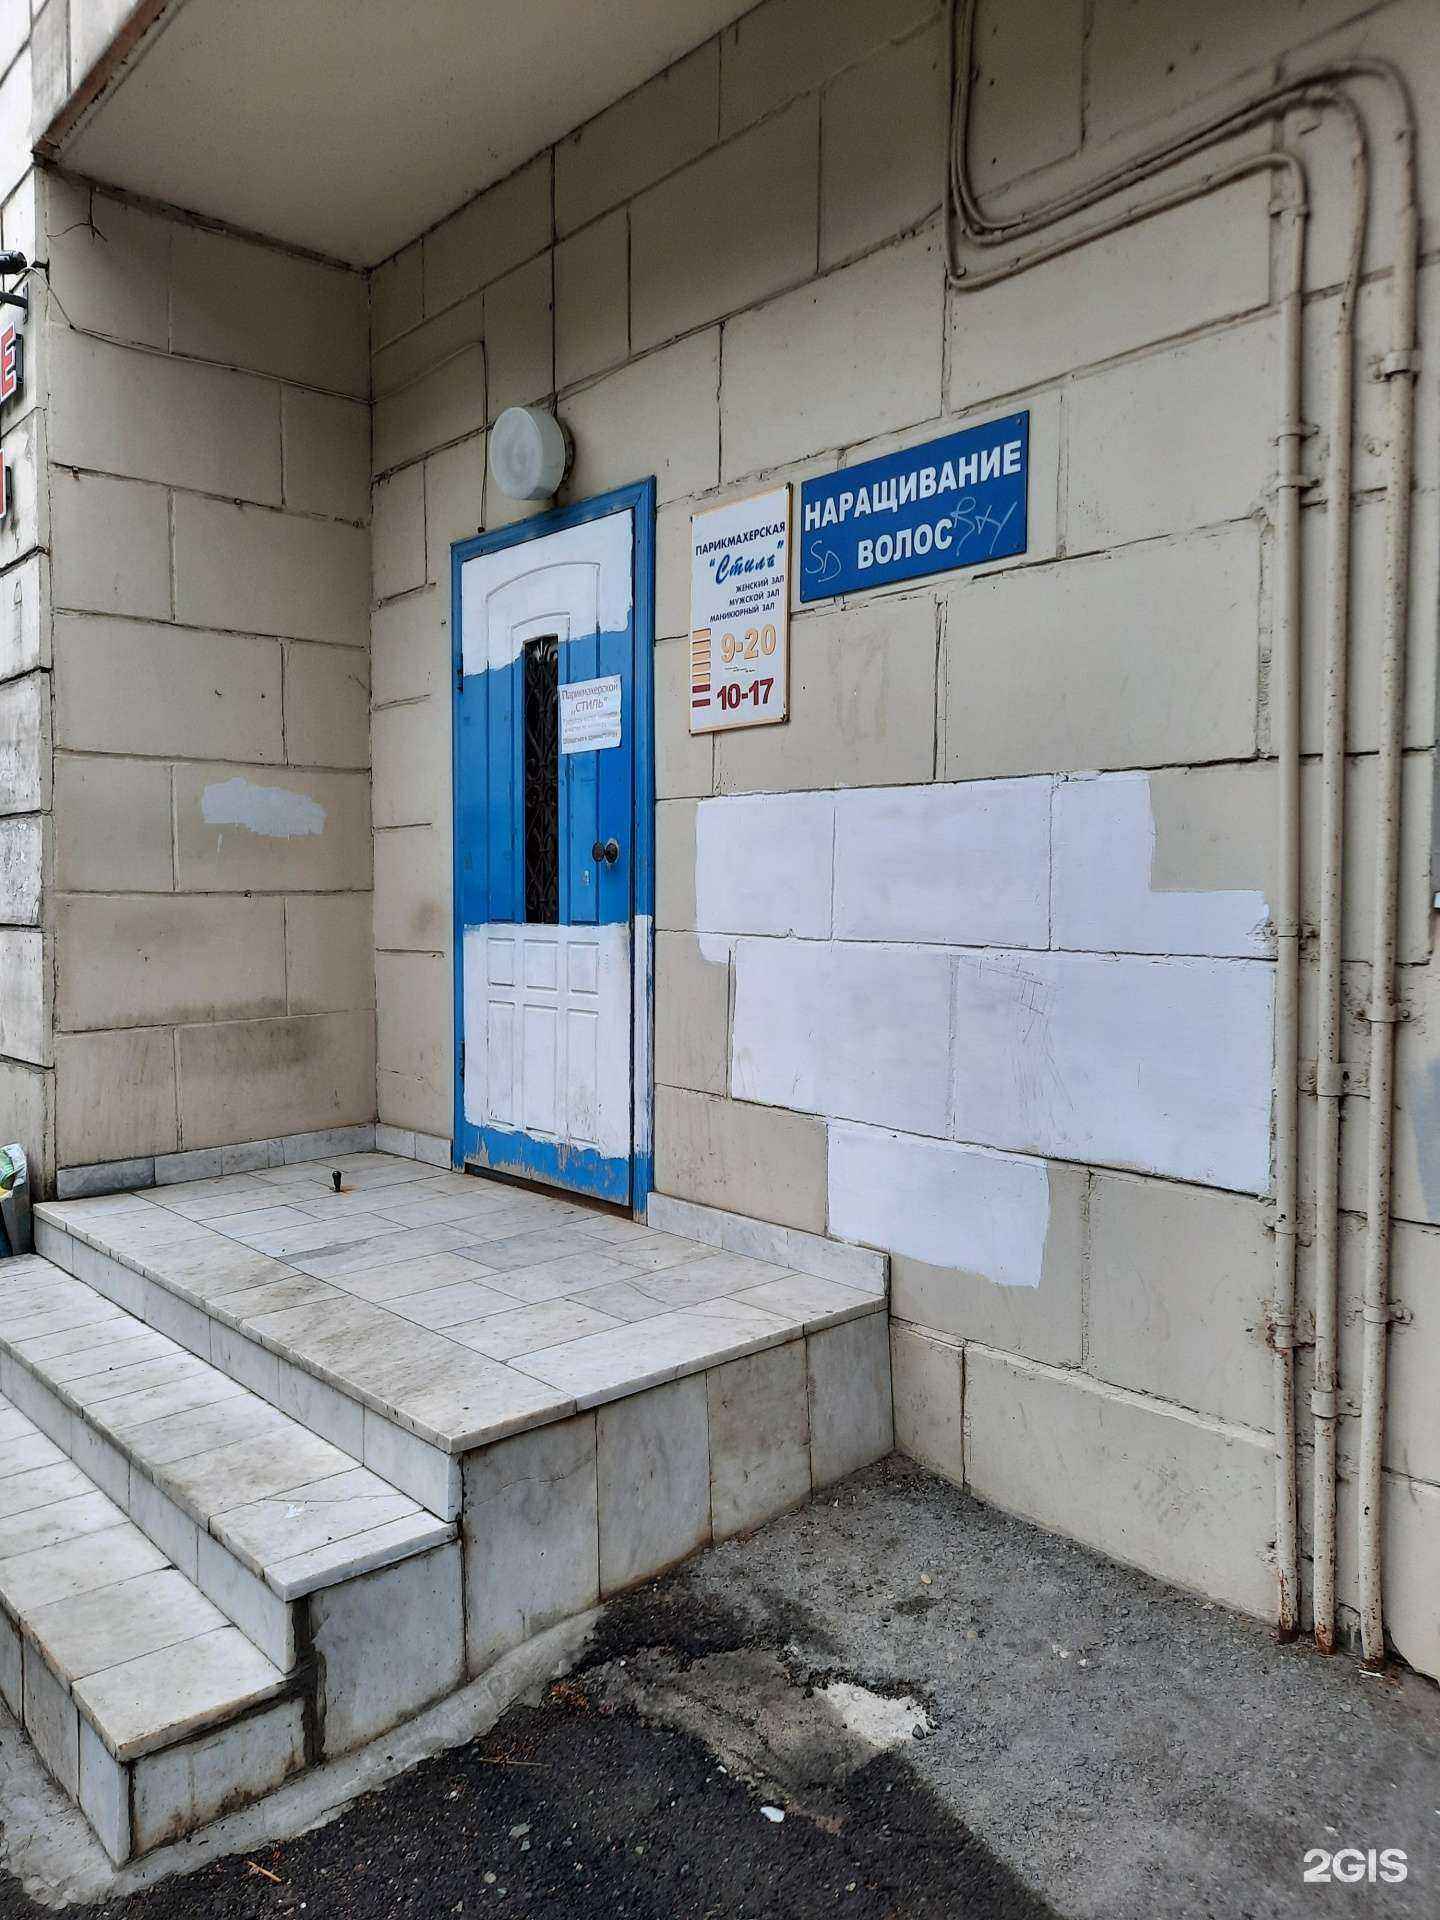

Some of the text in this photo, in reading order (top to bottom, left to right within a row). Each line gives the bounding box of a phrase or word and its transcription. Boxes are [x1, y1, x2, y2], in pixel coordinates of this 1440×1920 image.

[804, 440, 1022, 532] НАРАЩИВАНИЕ
[695, 521, 786, 556] ПАРИКМАХЕРСКАЯ
[857, 518, 953, 570] ВОЛОС
[728, 589, 780, 606] МУЖСКОЙ ЗАЛ
[735, 575, 785, 593] ЖЕНСКИЙ ЗАЛ
[709, 602, 775, 622] МАНИКЮРНЫЙ ЗАЛ
[720, 623, 777, 664] 9-20
[716, 677, 775, 711] 10-17
